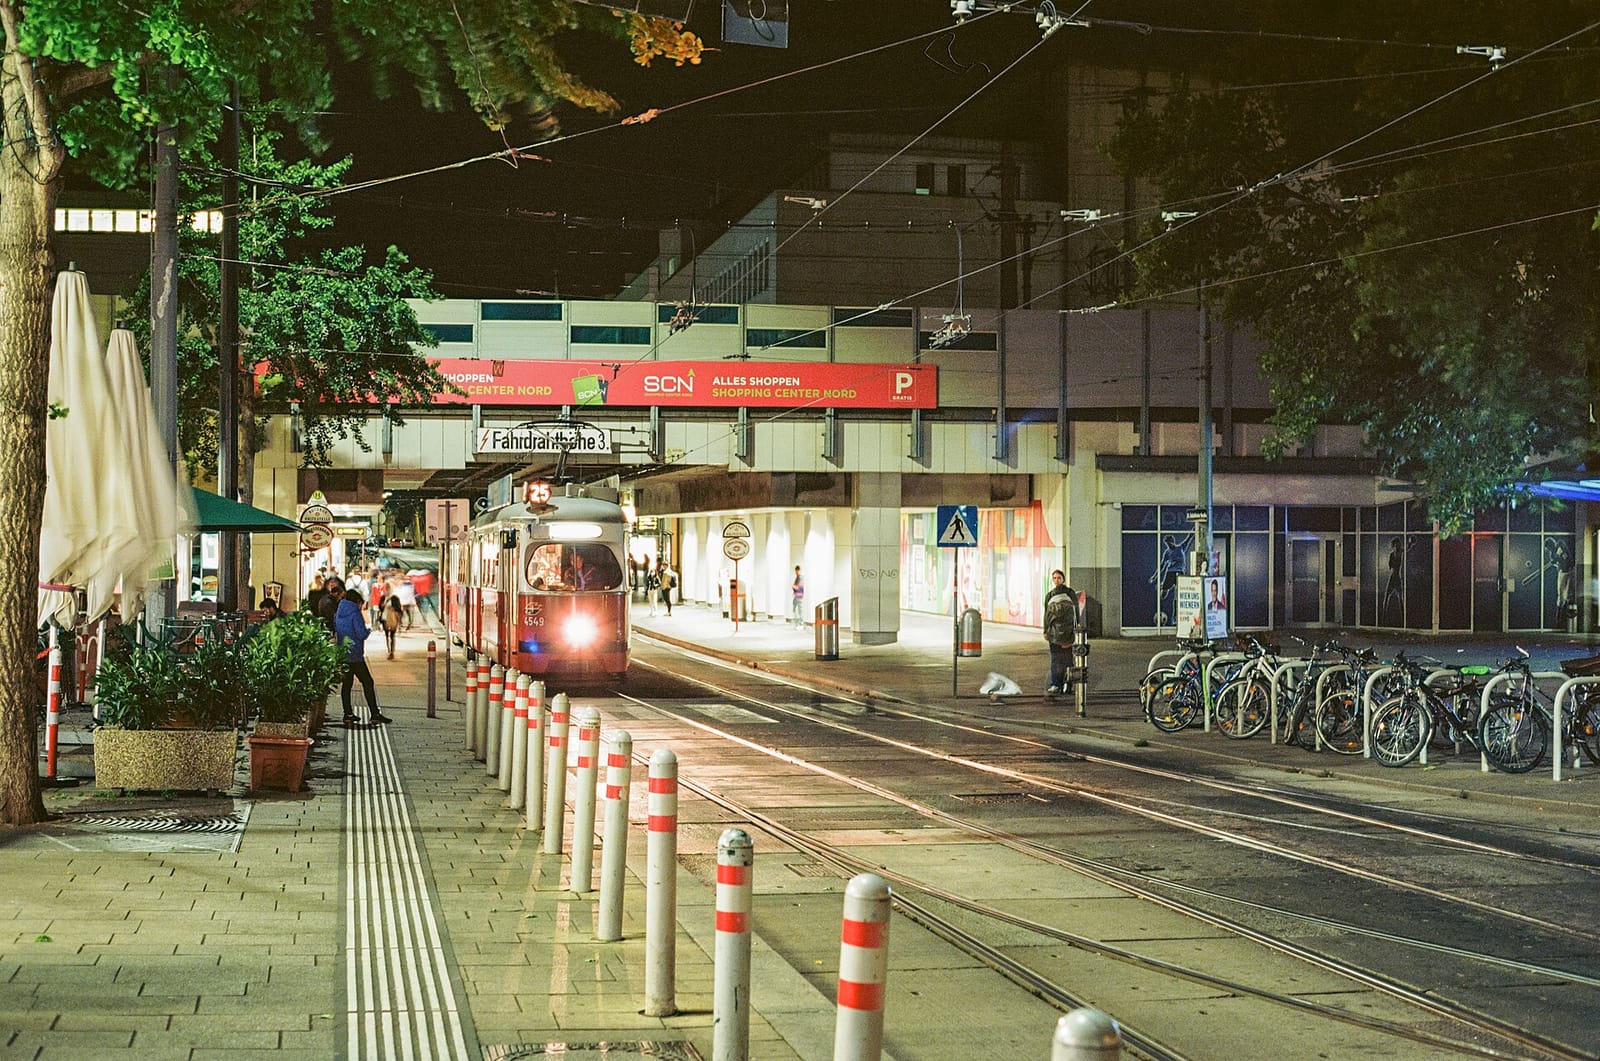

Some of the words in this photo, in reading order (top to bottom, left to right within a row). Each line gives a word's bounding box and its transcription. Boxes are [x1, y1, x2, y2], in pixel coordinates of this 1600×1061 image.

[643, 375, 694, 393] SCN
[712, 376, 747, 386] ALLES
[749, 376, 800, 386] SHOPPEN
[895, 372, 913, 394] P
[467, 385, 514, 395] CENTER
[517, 385, 552, 396] NORD
[711, 387, 771, 398] SHOPPING
[774, 388, 820, 398] CENTER
[823, 389, 857, 399] NORD
[530, 484, 549, 502] 25
[524, 617, 545, 626] 4549
